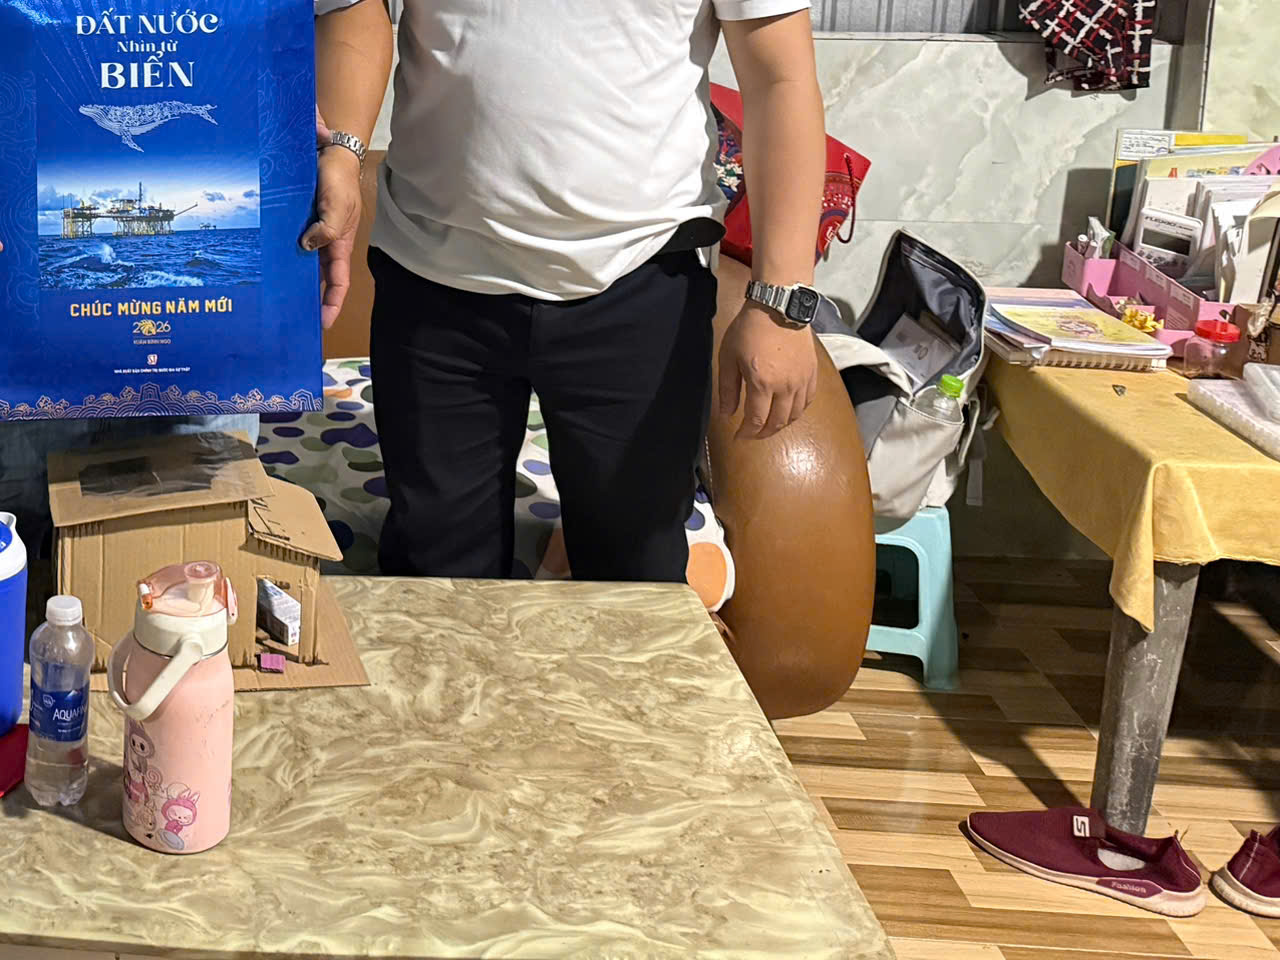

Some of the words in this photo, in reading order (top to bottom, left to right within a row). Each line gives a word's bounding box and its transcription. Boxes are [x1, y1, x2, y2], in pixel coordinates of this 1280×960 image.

[75, 7, 131, 36] ĐẤT
[138, 8, 219, 35] NƯỚC
[116, 39, 156, 53] Nhìn
[157, 40, 179, 53] từ
[100, 50, 195, 89] BIỂN
[70, 300, 112, 317] CHÚC
[117, 299, 162, 316] MỪNG
[165, 298, 200, 314] NĂM
[204, 296, 233, 313] MỚI
[1111, 880, 1147, 893] Fashion
